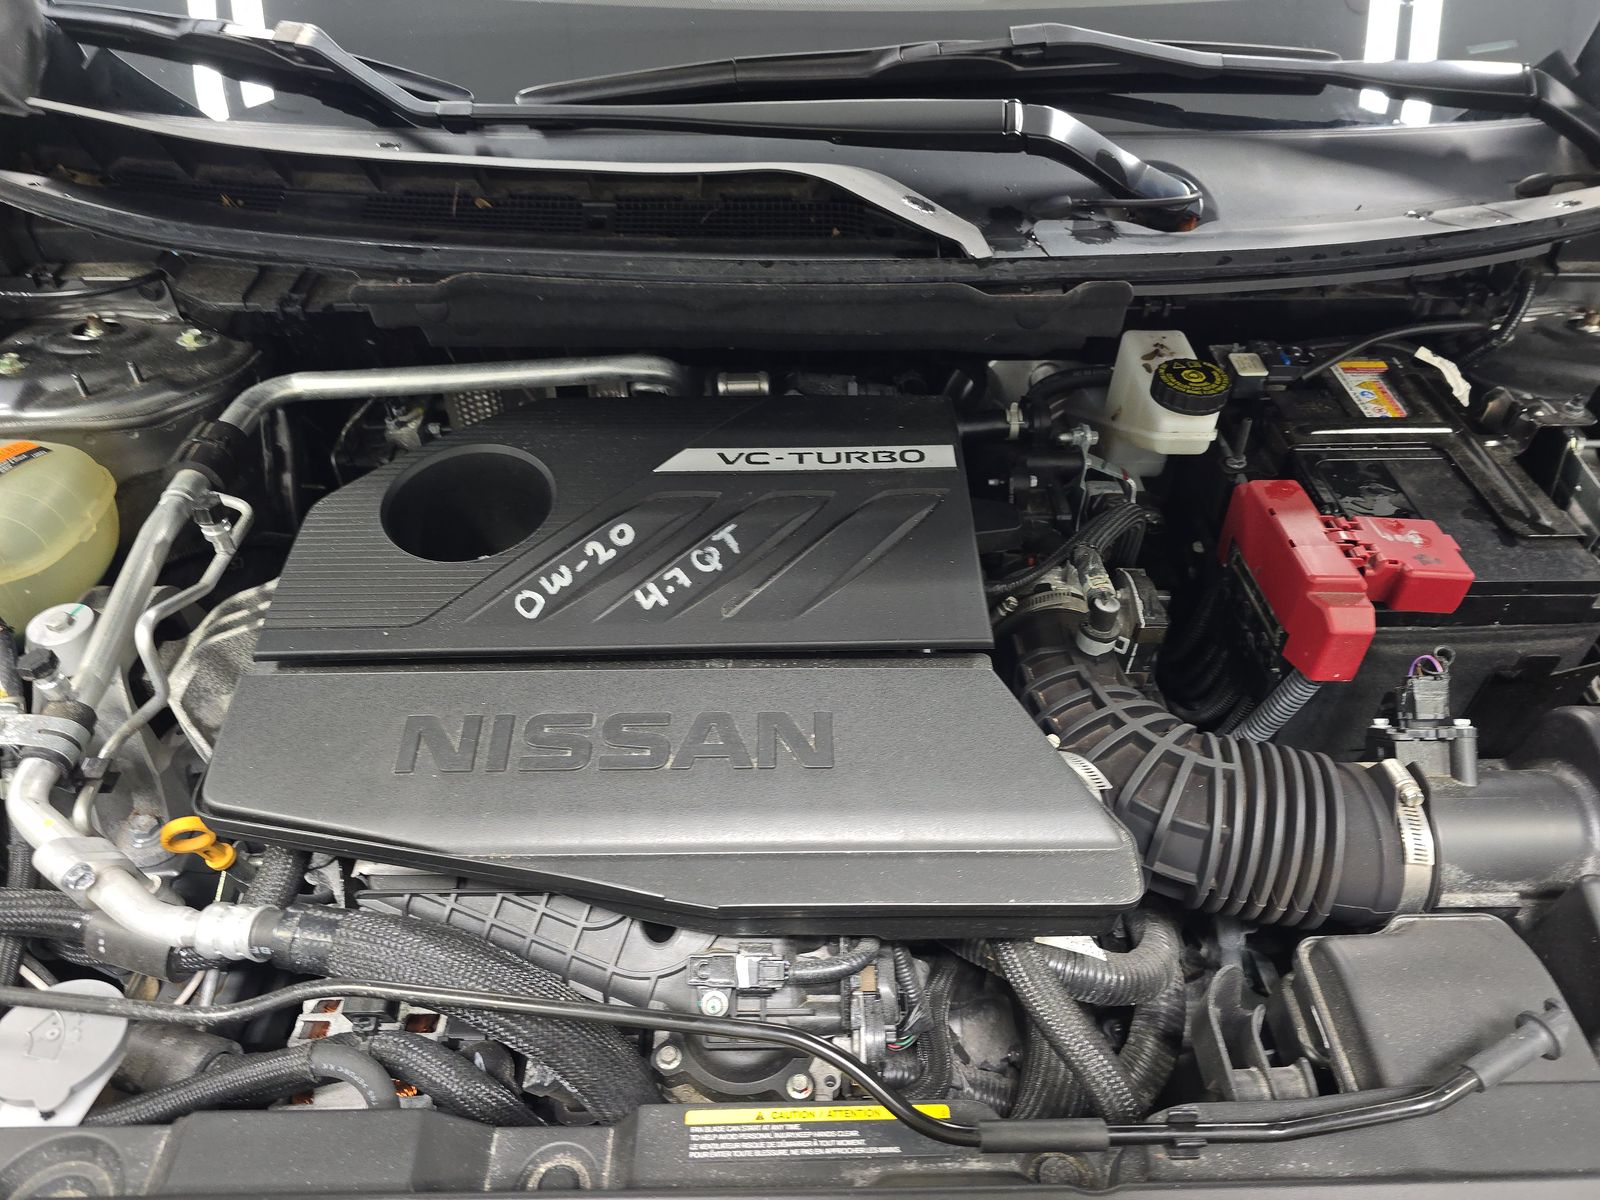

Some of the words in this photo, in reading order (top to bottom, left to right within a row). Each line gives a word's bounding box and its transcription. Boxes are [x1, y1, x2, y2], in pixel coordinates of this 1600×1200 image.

[717, 449, 926, 465] VC-TURBO
[633, 567, 693, 611] 4.7
[690, 523, 741, 573] QT
[393, 711, 835, 774] NISSAN
[771, 1110, 815, 1120] CAUTION
[827, 1108, 881, 1118] ATTENTION
